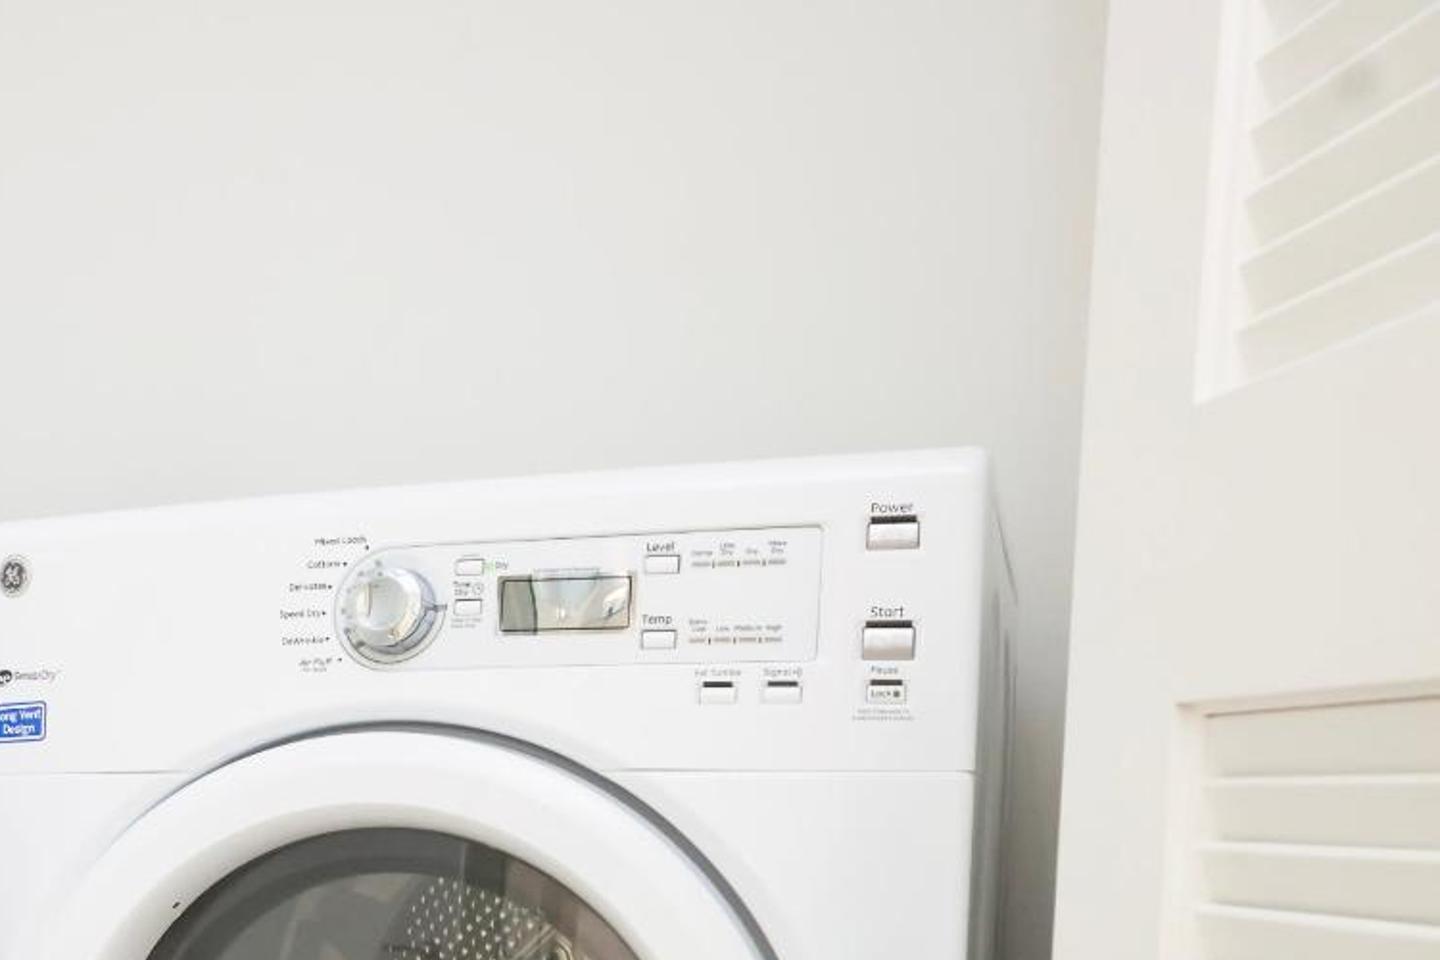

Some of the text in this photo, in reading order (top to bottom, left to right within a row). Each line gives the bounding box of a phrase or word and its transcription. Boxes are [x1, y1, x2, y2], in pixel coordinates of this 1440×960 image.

[870, 502, 913, 513] Power
[646, 541, 676, 552] Level
[870, 605, 904, 618] Start
[641, 614, 673, 626] Temp
[19, 708, 43, 720] Vent
[2, 723, 36, 737] Design
